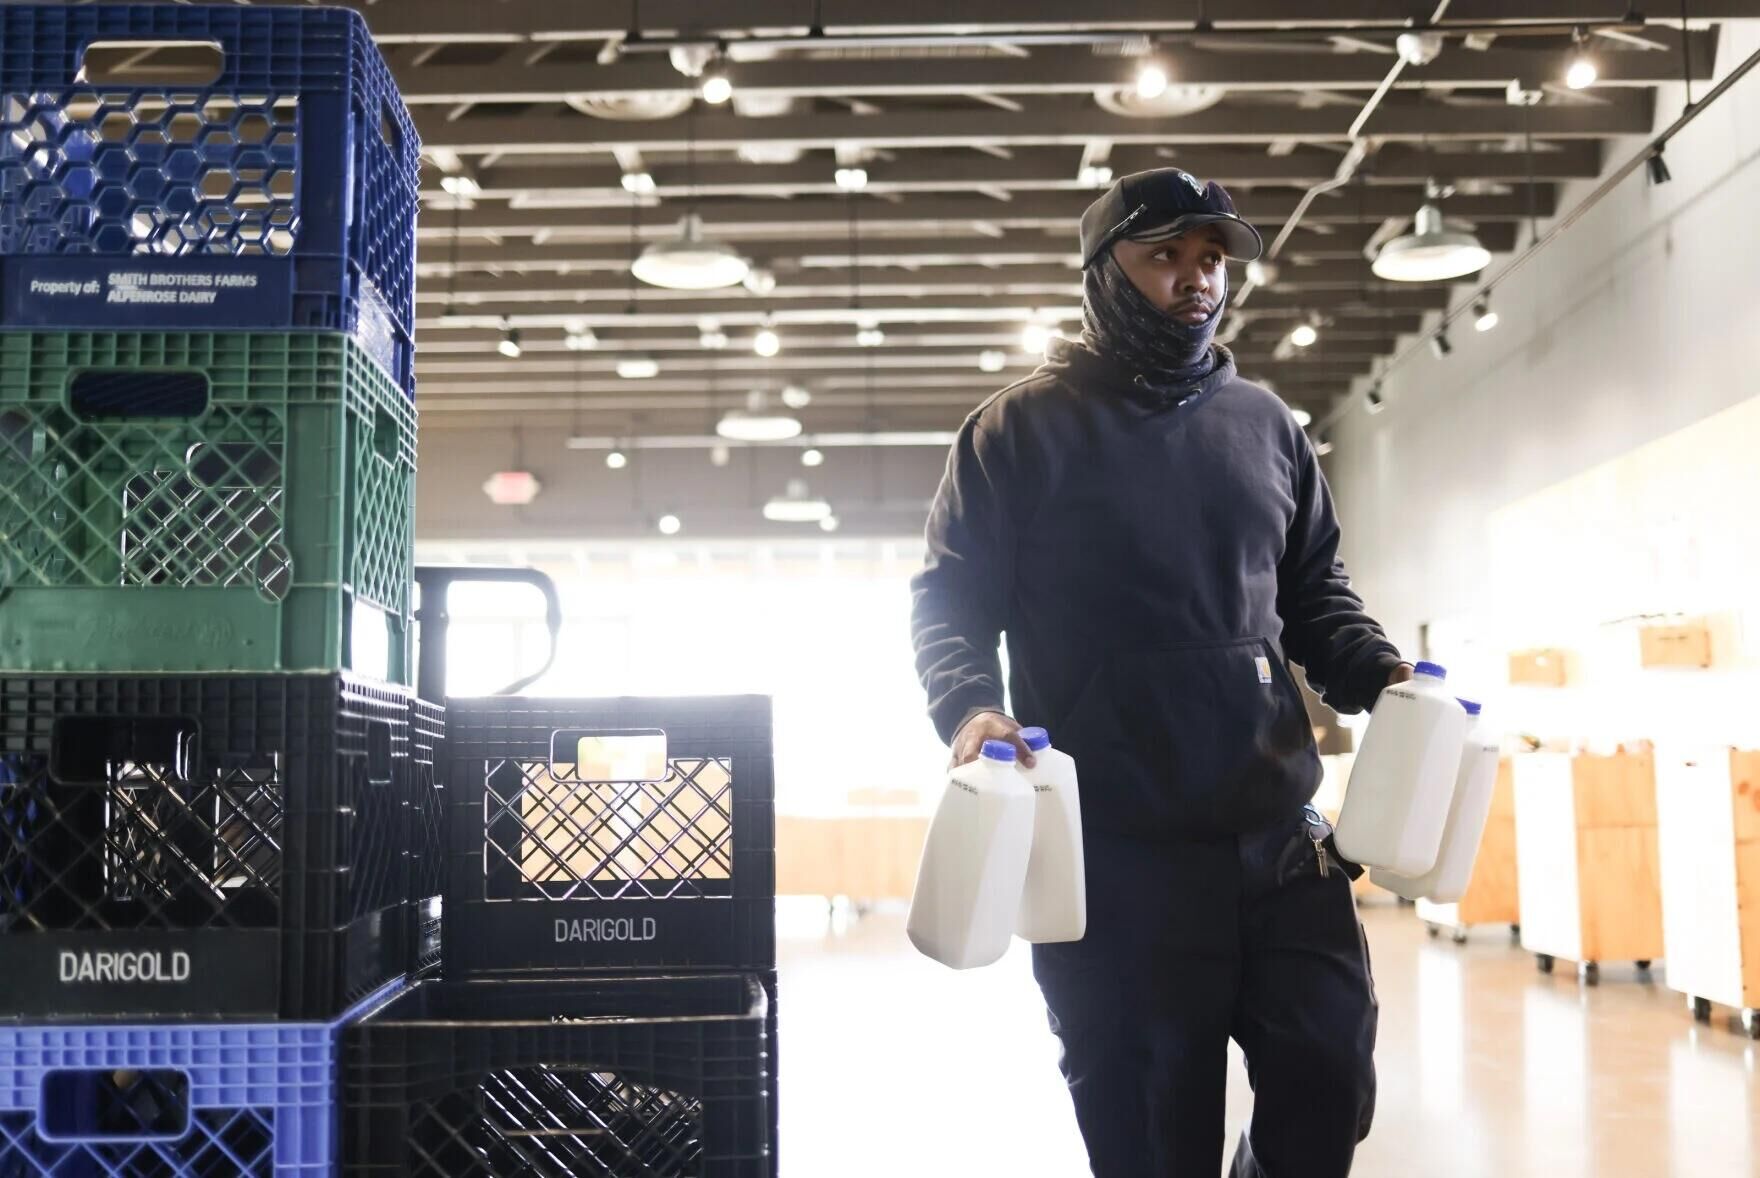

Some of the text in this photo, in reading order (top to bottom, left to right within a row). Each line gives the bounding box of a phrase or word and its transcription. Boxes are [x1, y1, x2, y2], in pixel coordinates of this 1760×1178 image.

[108, 273, 257, 286] SMITH BROTHERS FARMS
[30, 280, 100, 295] Property of:
[107, 290, 217, 302] ALPENROSE DAIRY
[554, 917, 656, 942] DARIGOLD
[59, 951, 191, 982] DARIGOLD
